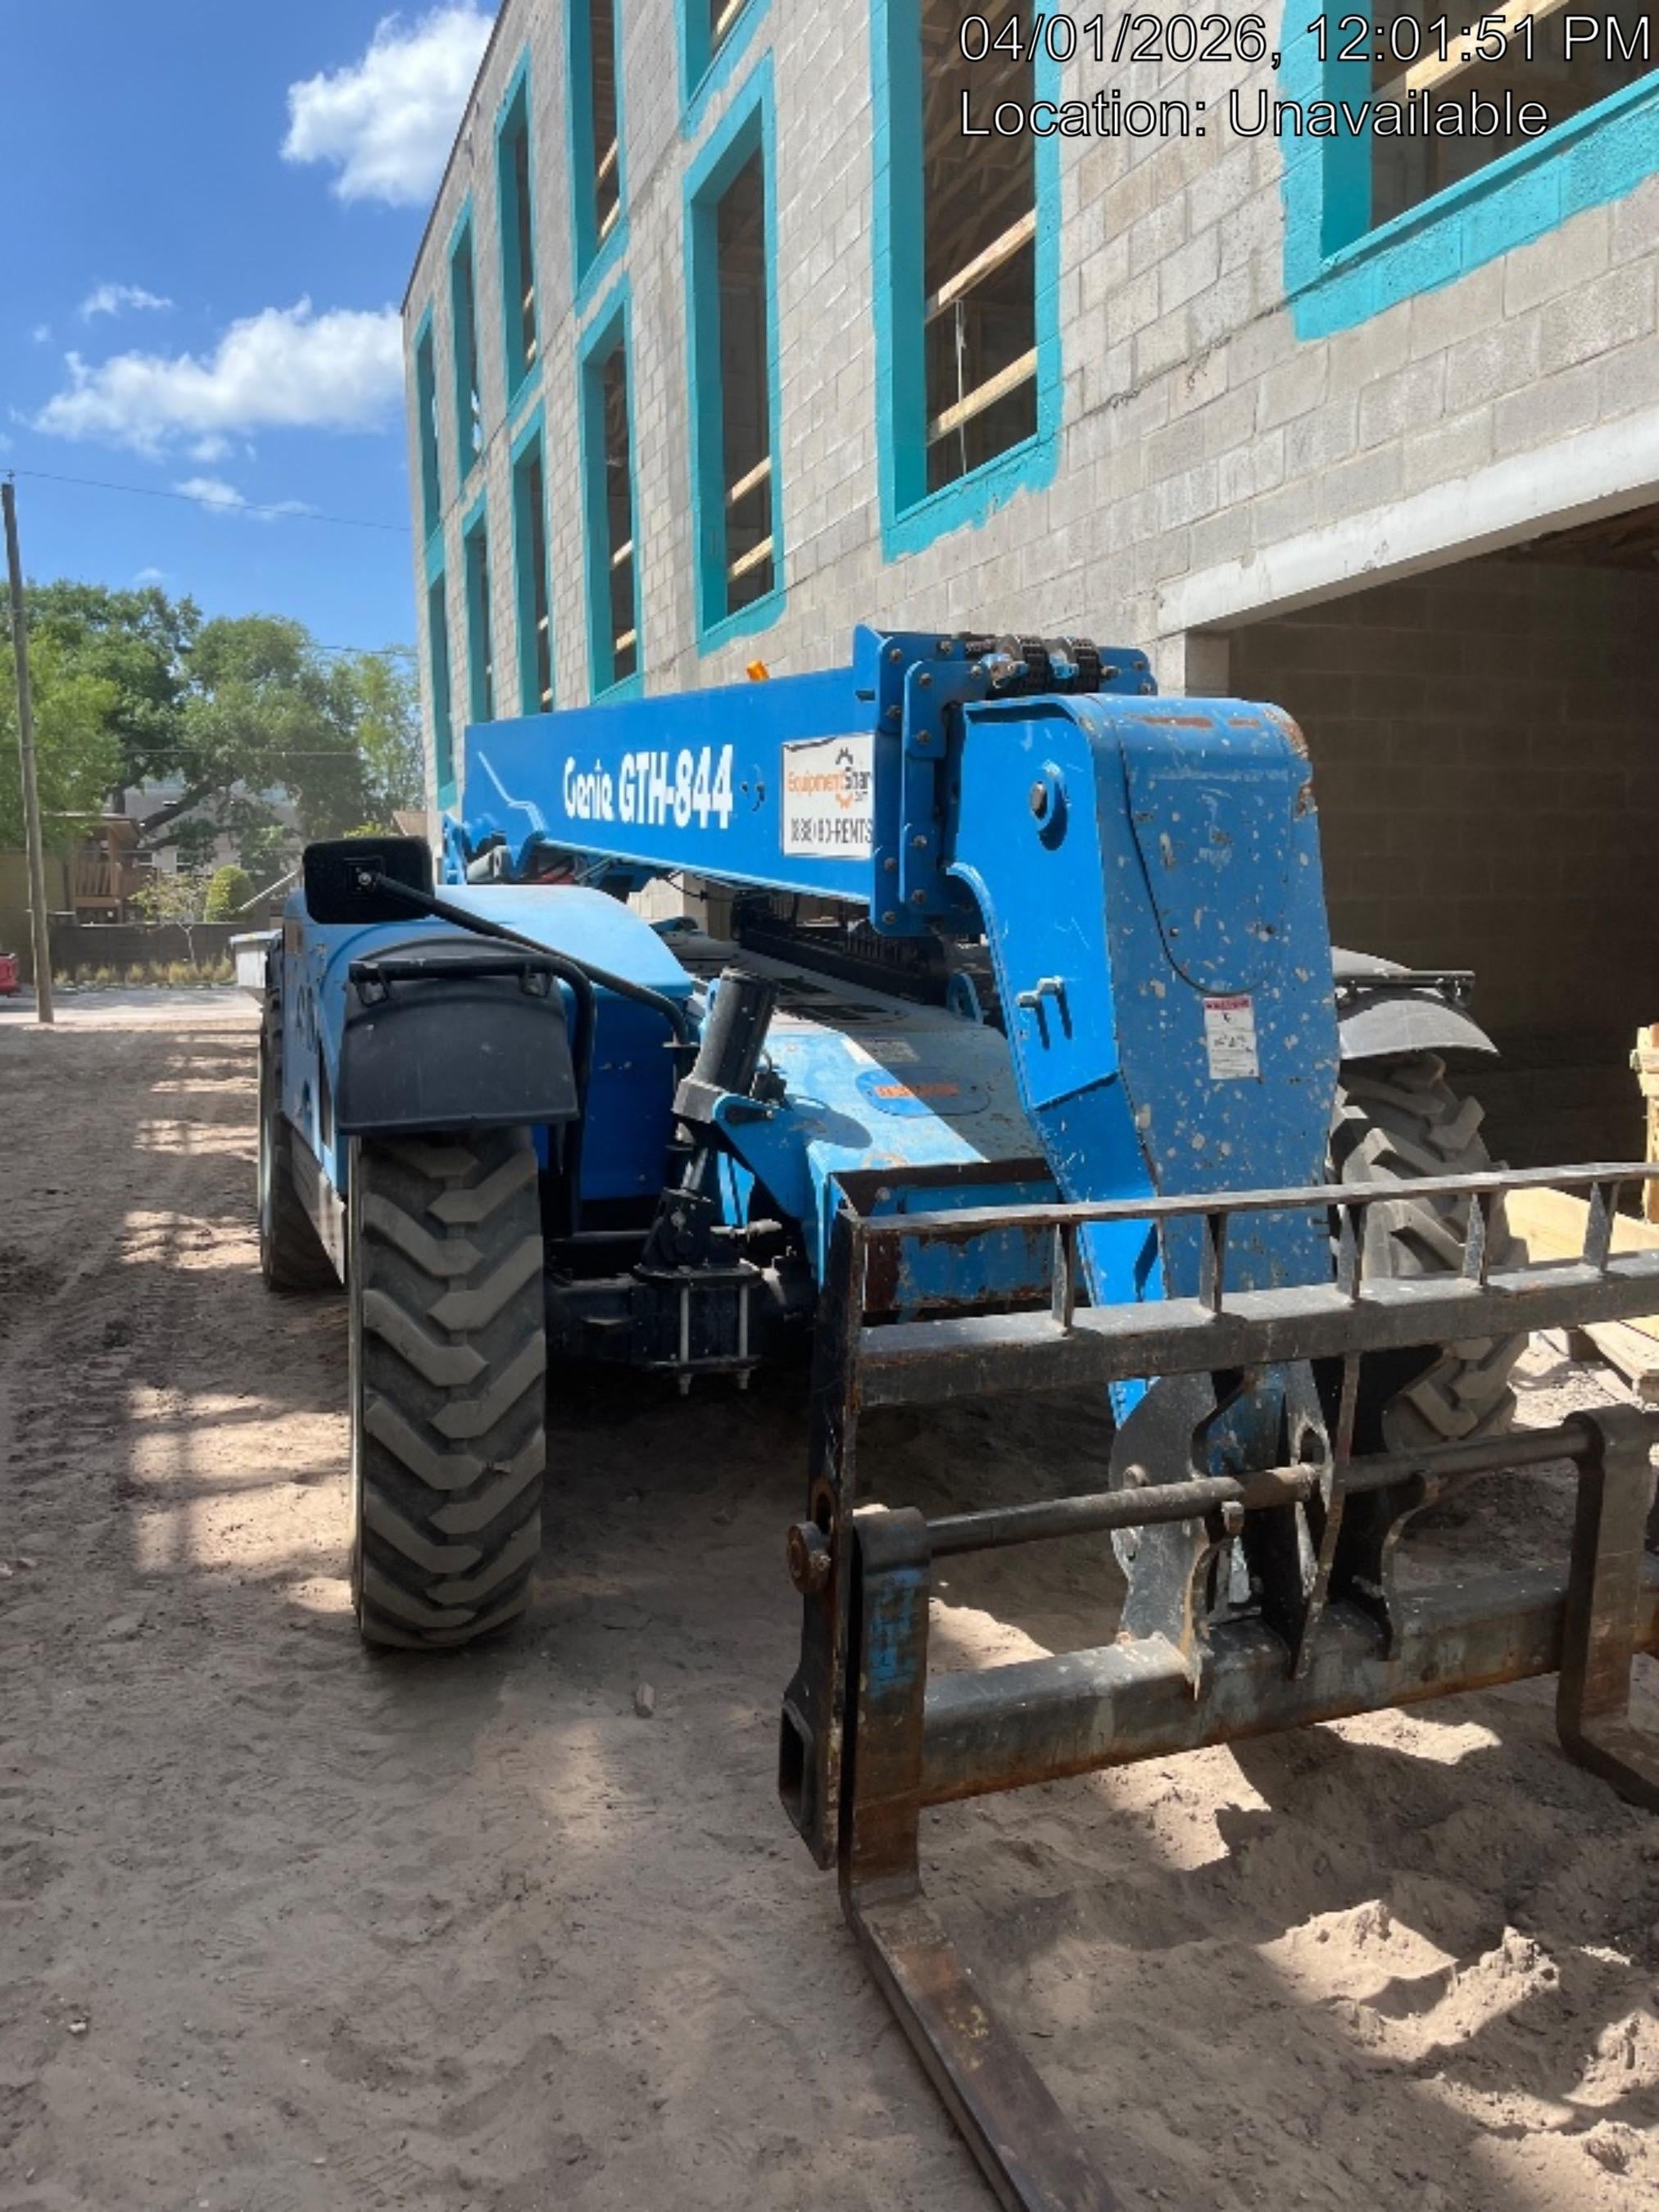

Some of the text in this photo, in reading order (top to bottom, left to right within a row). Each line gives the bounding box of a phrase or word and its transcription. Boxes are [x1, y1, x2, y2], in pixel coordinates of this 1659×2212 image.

[564, 744, 734, 830] Genie GTH-844
[787, 767, 871, 795] EquipmentShar
